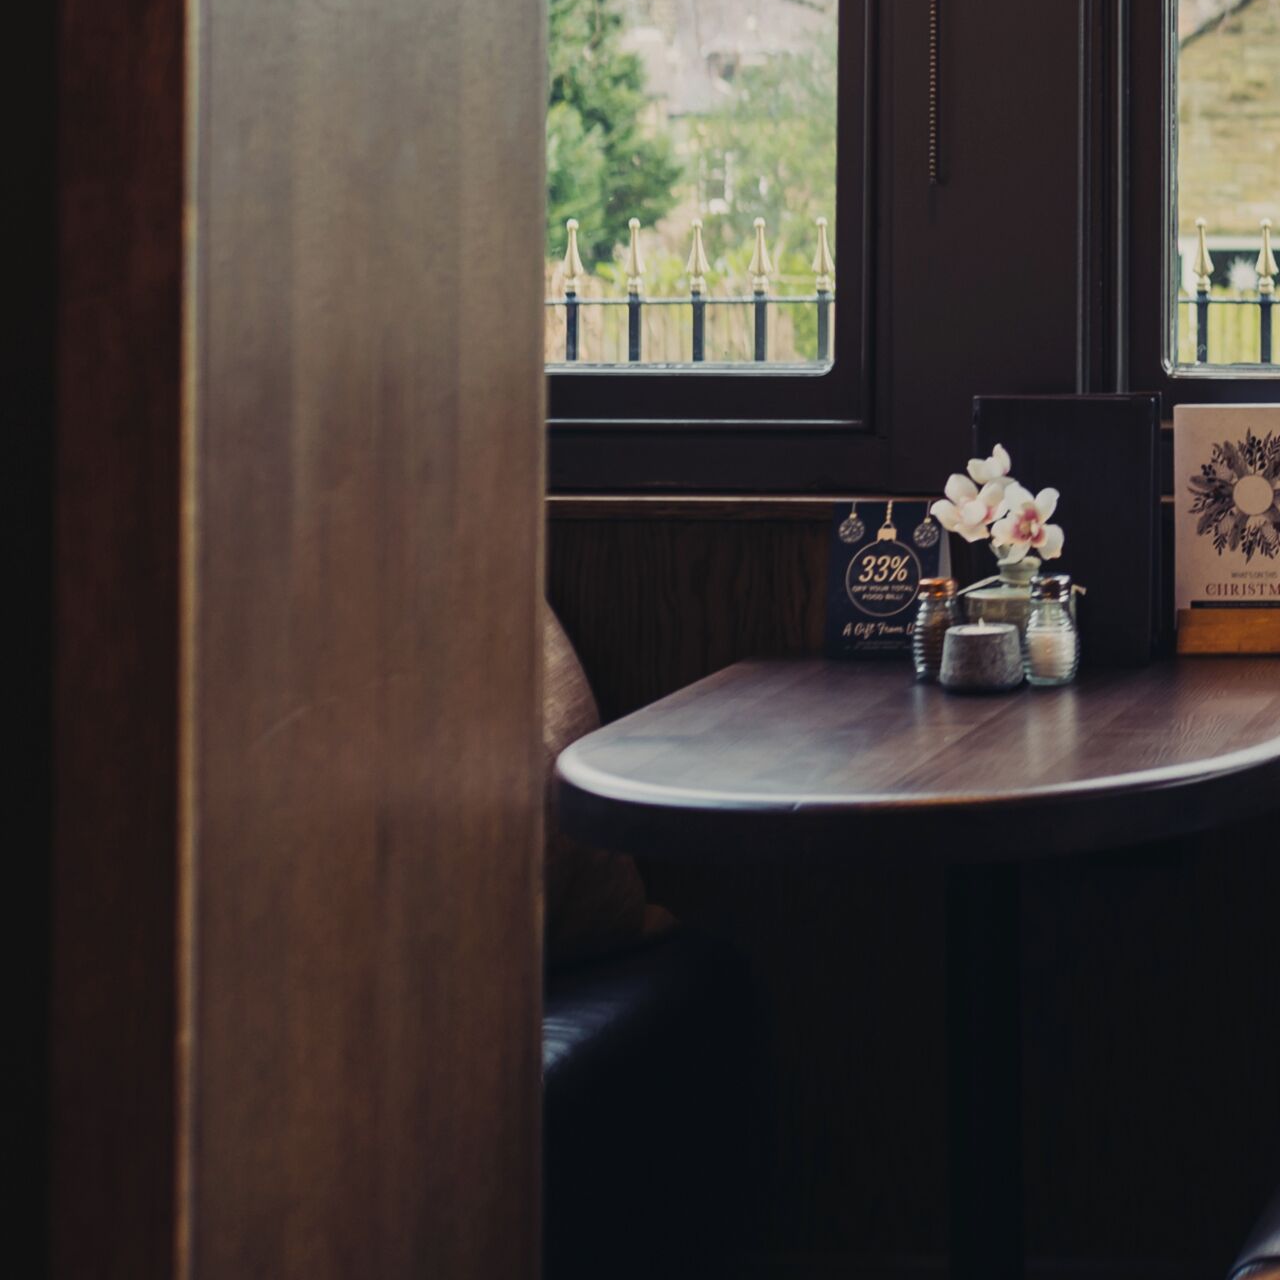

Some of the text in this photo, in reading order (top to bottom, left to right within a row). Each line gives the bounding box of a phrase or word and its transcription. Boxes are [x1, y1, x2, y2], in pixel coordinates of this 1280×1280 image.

[859, 555, 910, 582] 33%
[851, 585, 867, 593] OFF
[842, 622, 852, 637] A
[854, 622, 876, 640] Gift
